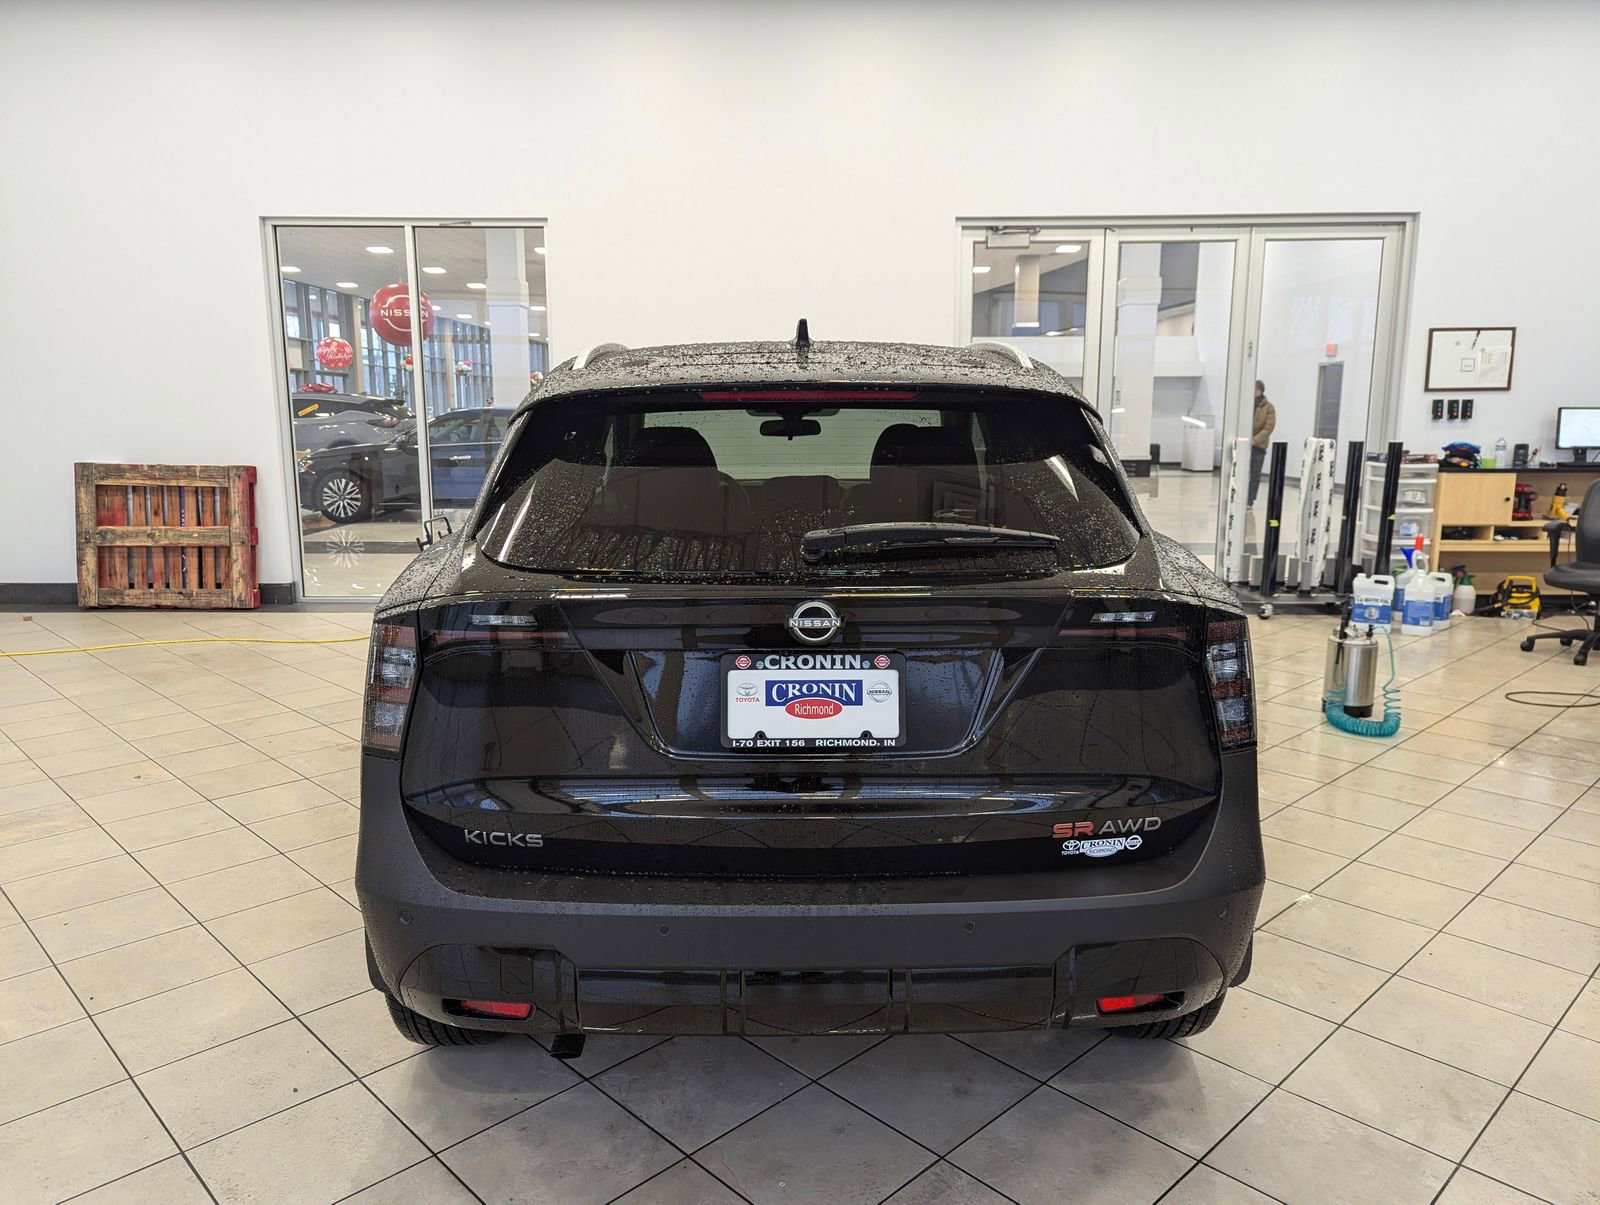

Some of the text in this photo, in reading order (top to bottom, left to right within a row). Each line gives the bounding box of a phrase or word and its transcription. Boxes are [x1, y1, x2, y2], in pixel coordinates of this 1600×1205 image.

[380, 309, 429, 317] NISSN
[789, 619, 840, 627] NISSAN
[764, 654, 861, 669] CRONIN
[771, 682, 857, 703] CRONIN
[794, 703, 834, 715] Richmond
[1052, 816, 1162, 839] SR AWD
[464, 829, 544, 847] KICKS
[1081, 839, 1124, 850] CRONIN
